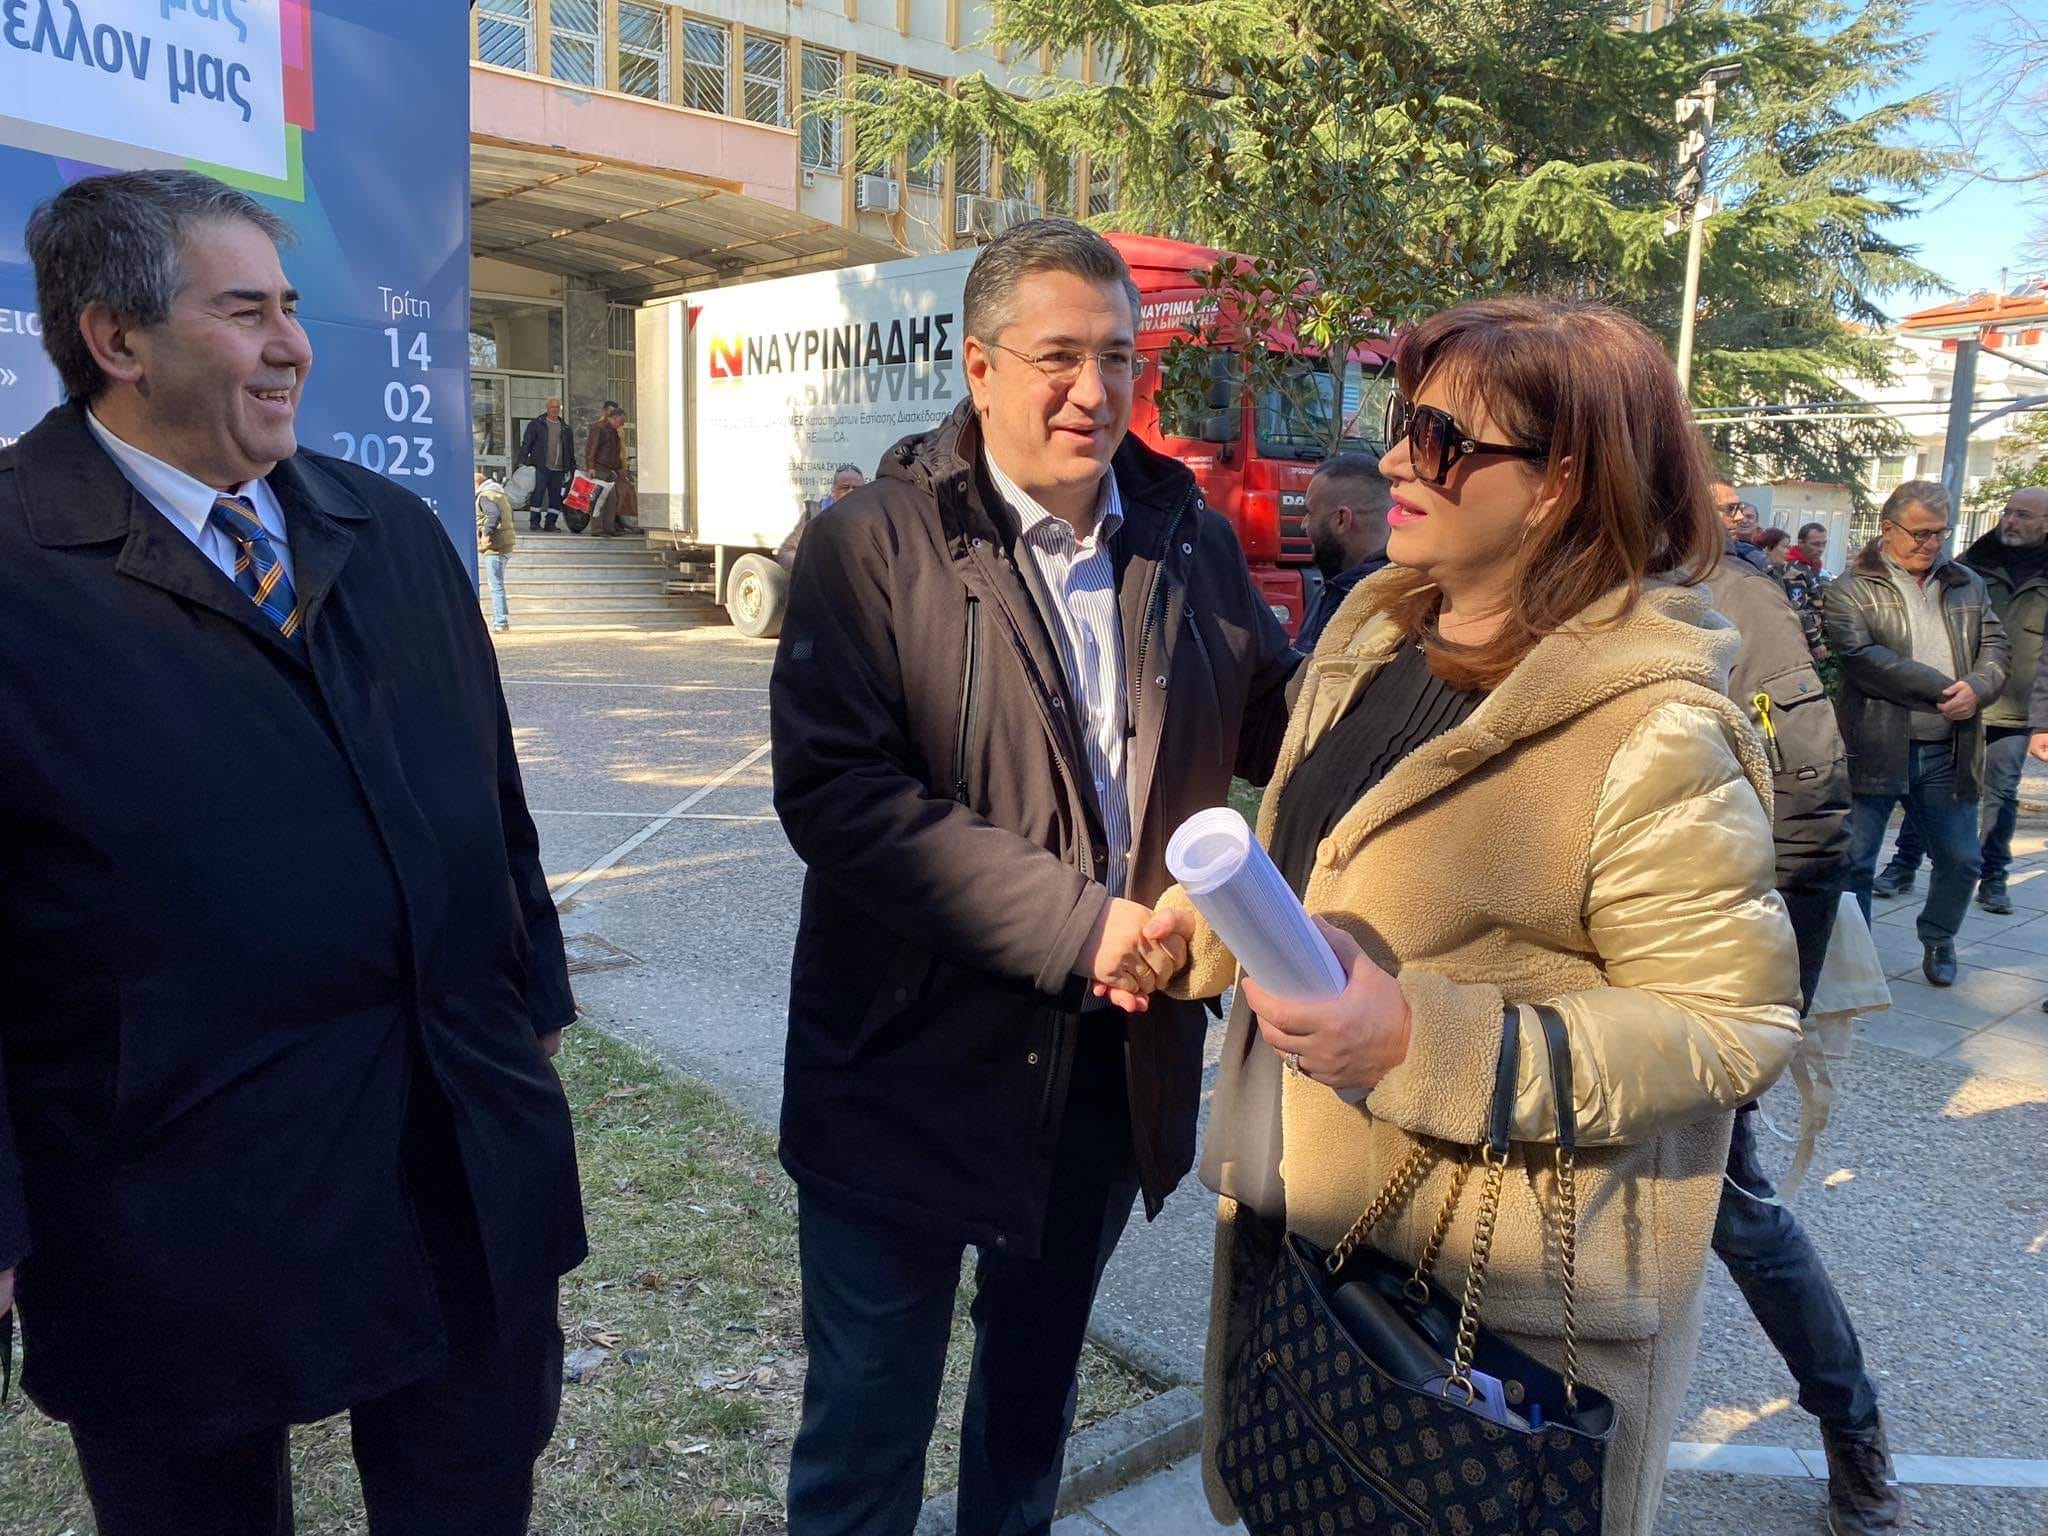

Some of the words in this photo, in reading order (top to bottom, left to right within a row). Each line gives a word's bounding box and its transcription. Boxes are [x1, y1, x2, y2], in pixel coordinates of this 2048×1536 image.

[167, 43, 252, 123] μας
[378, 286, 431, 320] Τρίτη
[1140, 297, 1219, 319] ΝΑΥΡΙΝΙΑΗΣ
[384, 328, 432, 371] 14
[748, 313, 954, 376] ΝΑΥΡΙΝΙΑΔΗΣ
[384, 381, 433, 424] 02
[332, 431, 435, 477] 2023
[1282, 495, 1305, 505] DA
